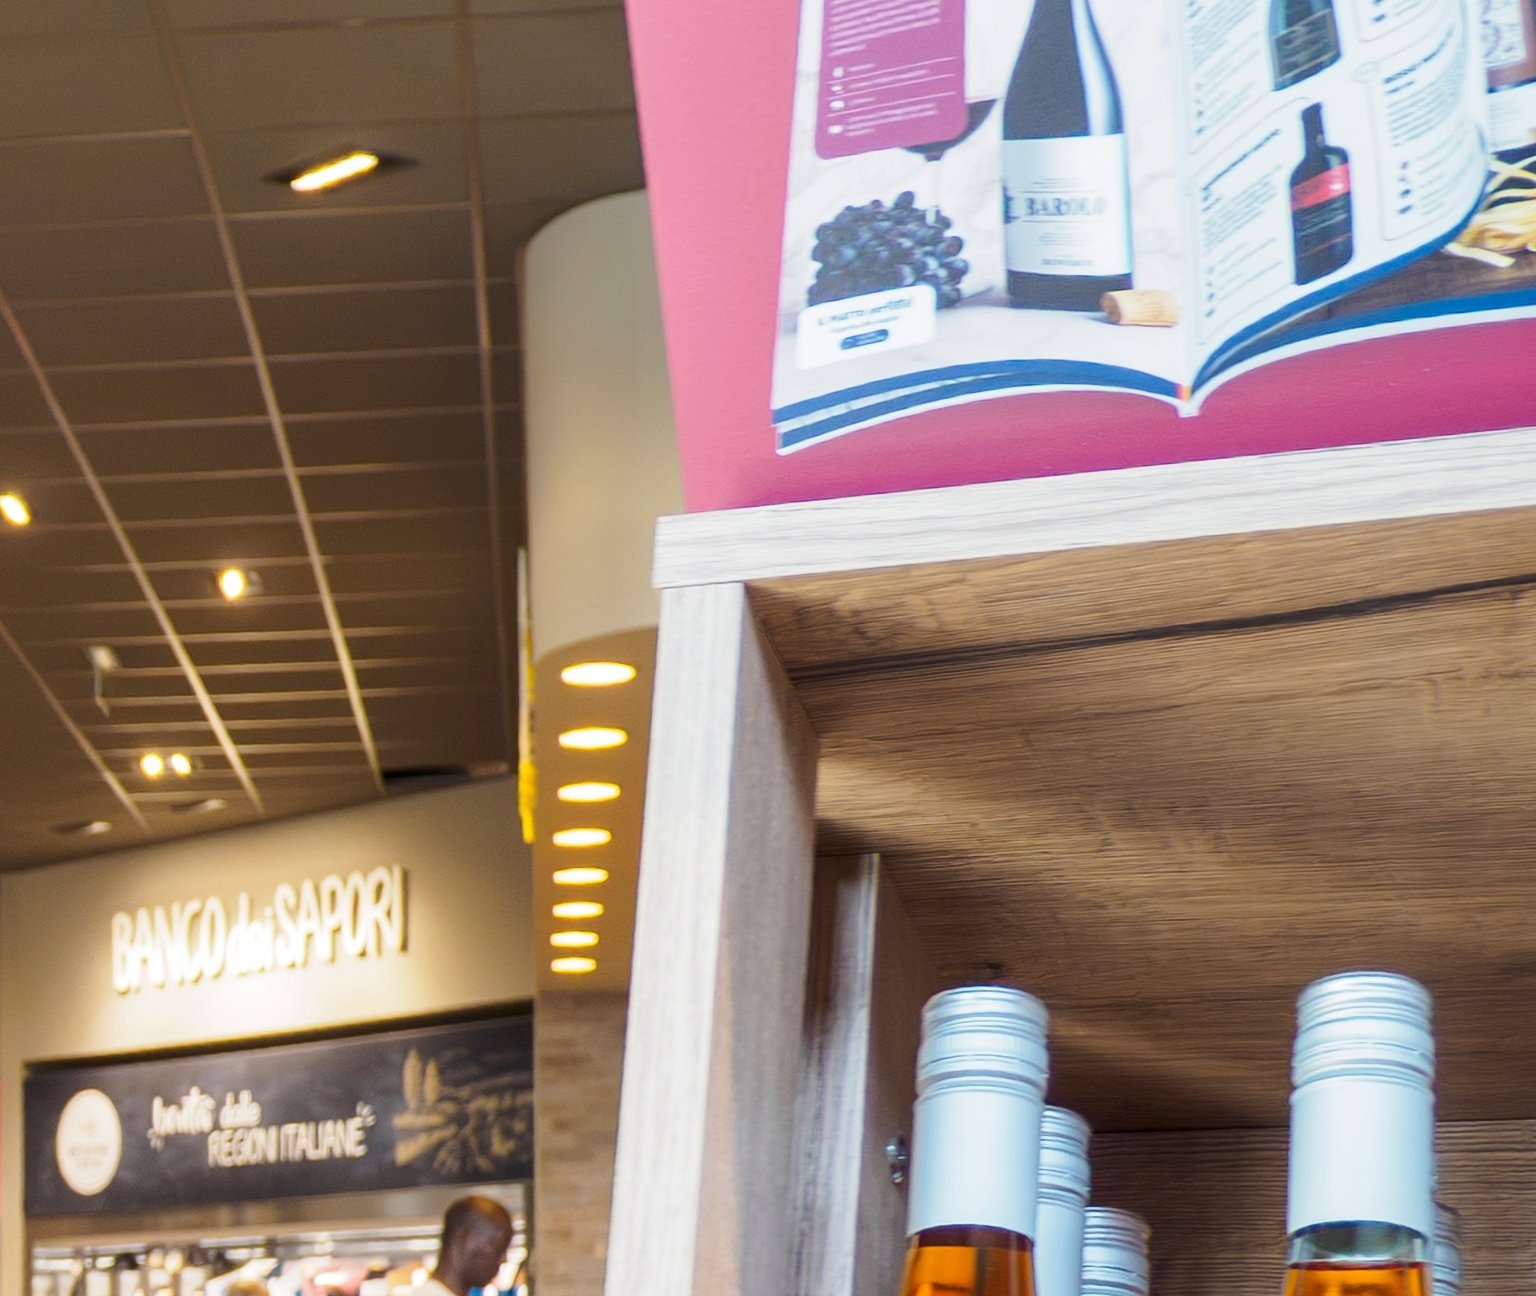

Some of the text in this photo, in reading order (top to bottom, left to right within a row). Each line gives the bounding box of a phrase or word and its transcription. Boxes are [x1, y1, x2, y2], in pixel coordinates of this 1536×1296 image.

[112, 896, 227, 995] BANCO
[275, 864, 408, 969] SAPORI
[280, 1117, 369, 1162] ITALIANE
